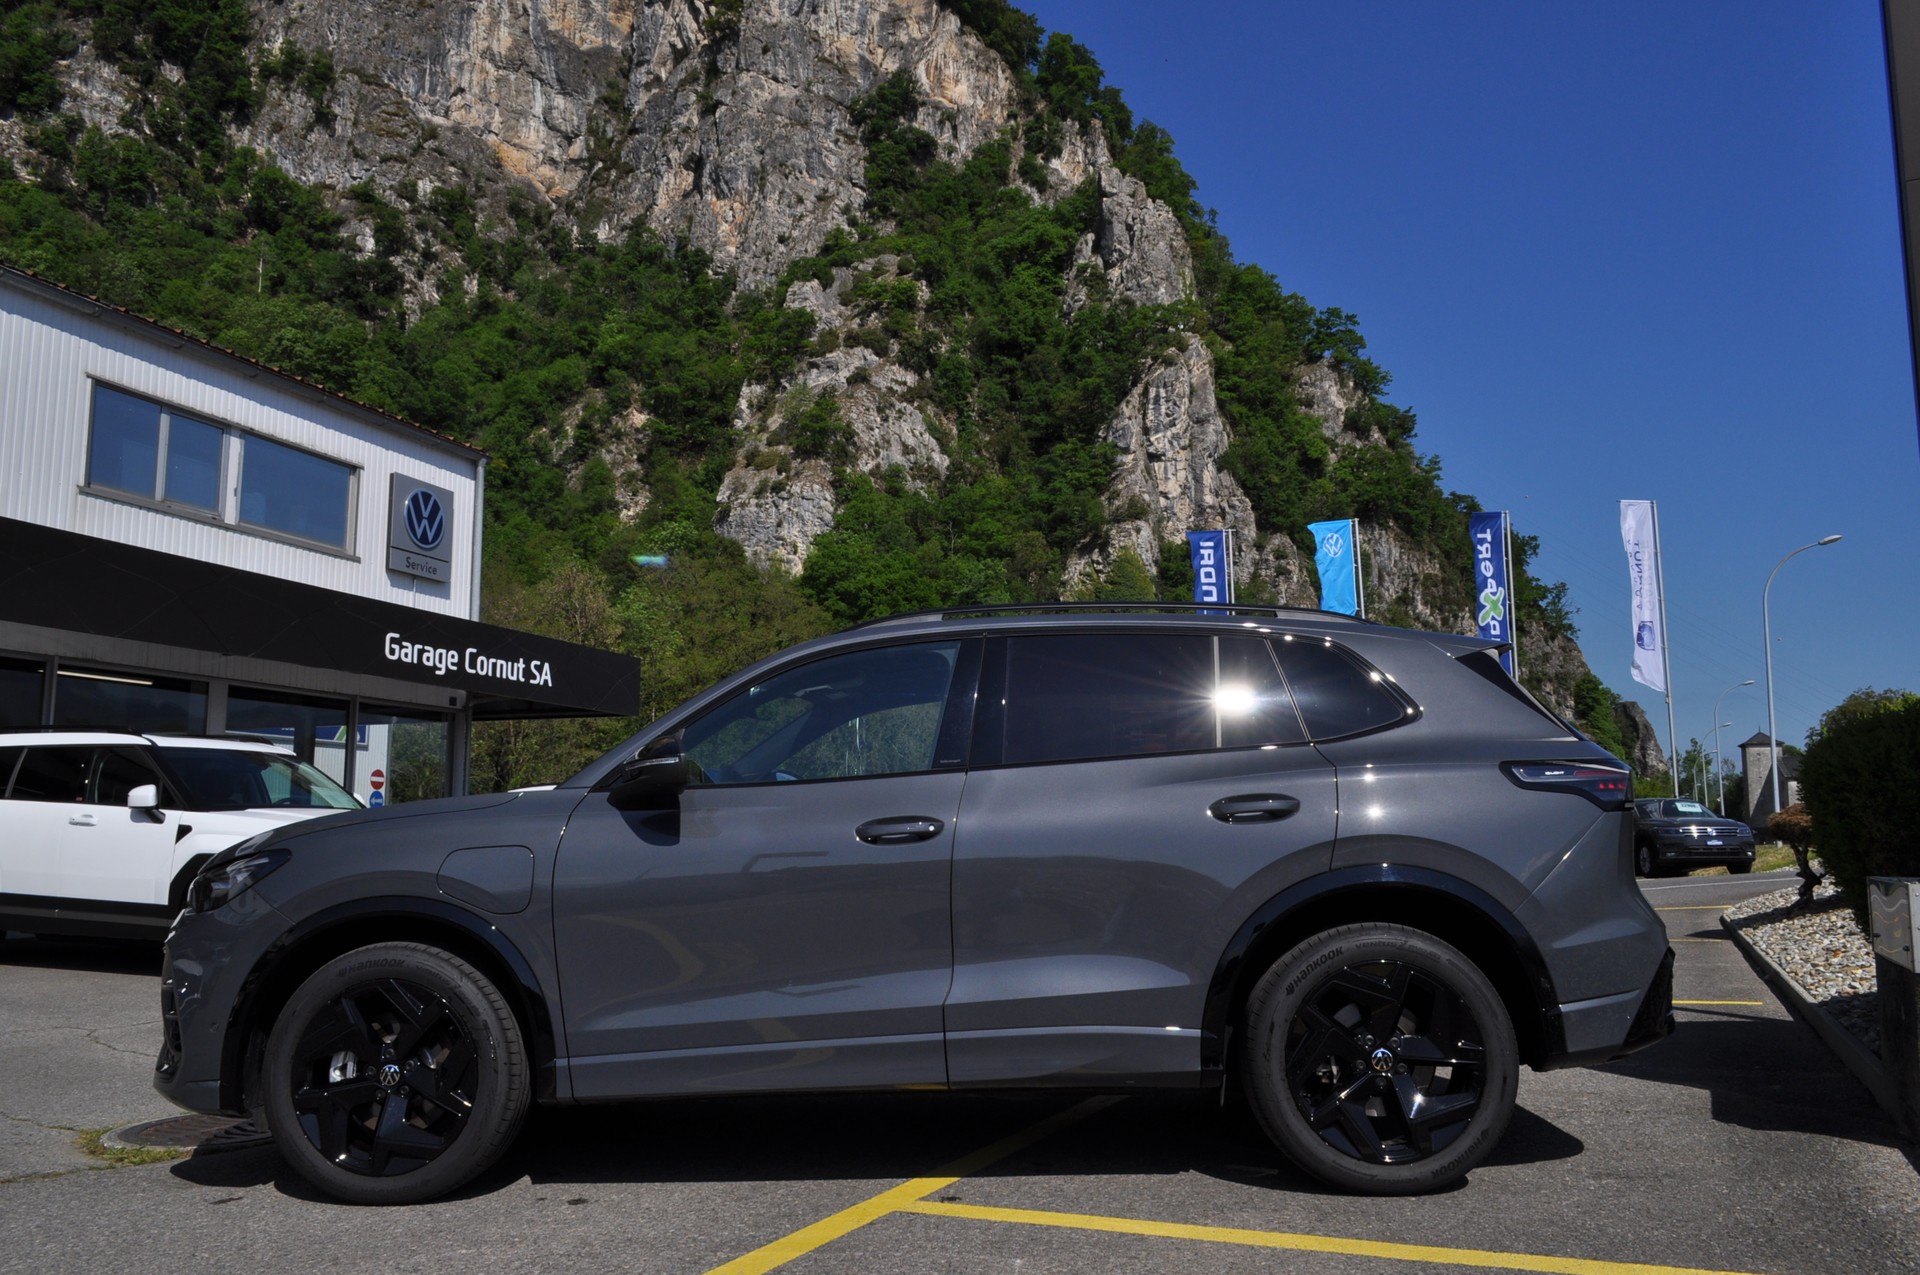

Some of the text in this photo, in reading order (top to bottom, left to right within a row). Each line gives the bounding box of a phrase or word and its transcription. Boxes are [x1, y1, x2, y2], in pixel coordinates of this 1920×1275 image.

[405, 556, 438, 576] Service
[384, 632, 553, 687] Garage Cornut SA
